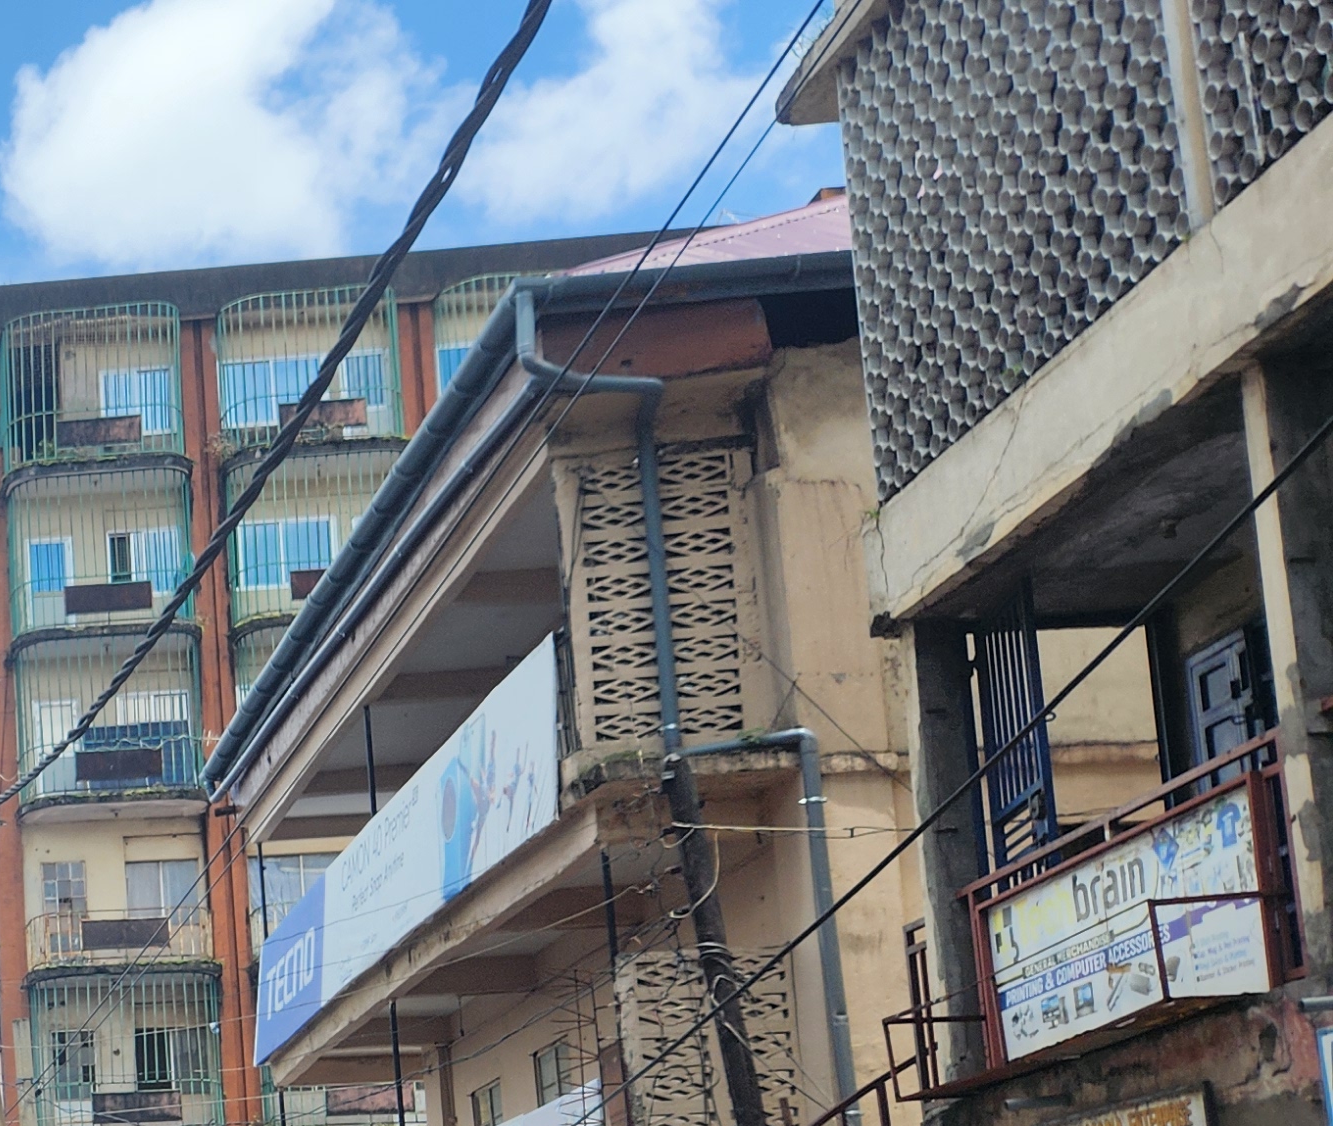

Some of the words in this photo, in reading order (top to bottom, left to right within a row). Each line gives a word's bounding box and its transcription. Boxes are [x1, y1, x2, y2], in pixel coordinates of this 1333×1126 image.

[341, 840, 371, 892] CAMON
[372, 824, 382, 856] 40
[383, 806, 411, 848] Premier
[351, 881, 369, 912] Perfect
[383, 852, 405, 885] Anytime
[266, 926, 315, 1021] TECNO
[1006, 980, 1043, 1007] PRINTING
[1045, 974, 1054, 992] &
[1056, 954, 1107, 986] COMPUTER
[1108, 924, 1170, 966] ACCESSORES
[1023, 954, 1056, 979] GENERAL
